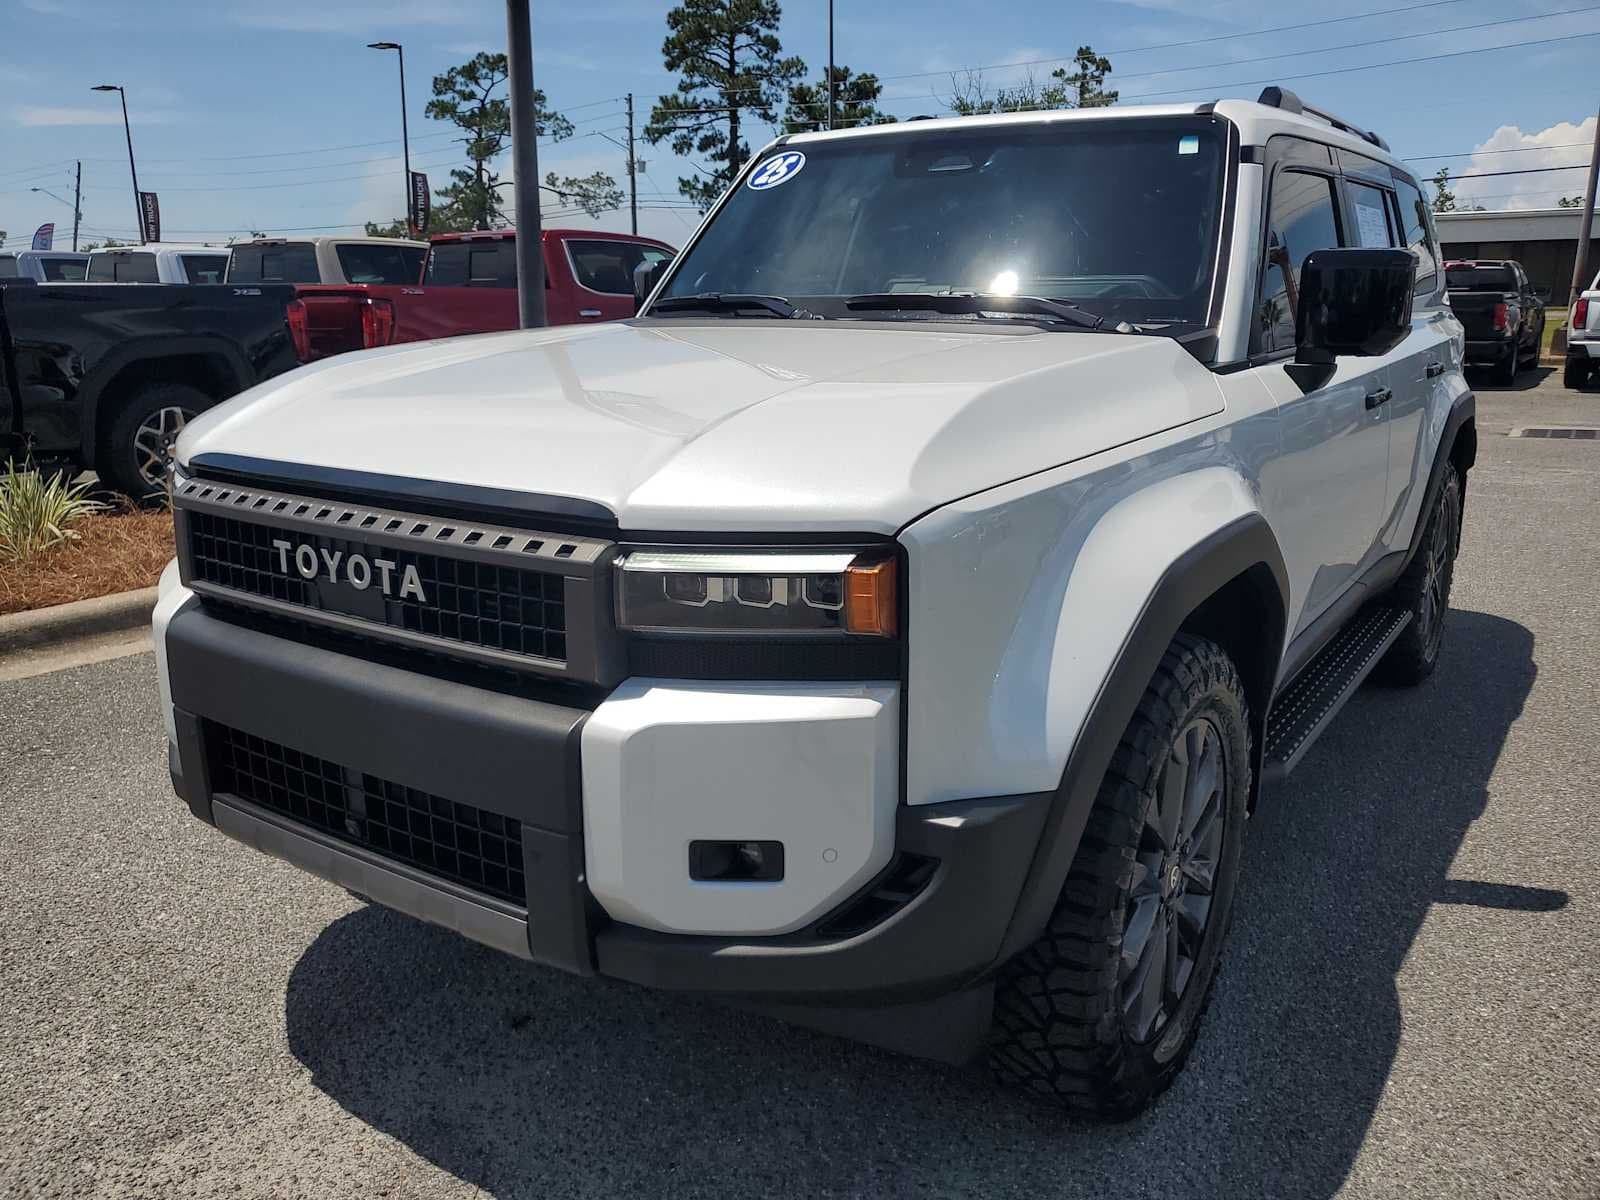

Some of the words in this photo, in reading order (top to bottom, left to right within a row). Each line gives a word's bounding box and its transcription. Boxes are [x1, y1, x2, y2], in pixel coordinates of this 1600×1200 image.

[753, 155, 800, 186] 25
[415, 175, 425, 208] TRUCKS
[416, 210, 425, 230] NEW
[272, 538, 427, 602] TOYOTA
